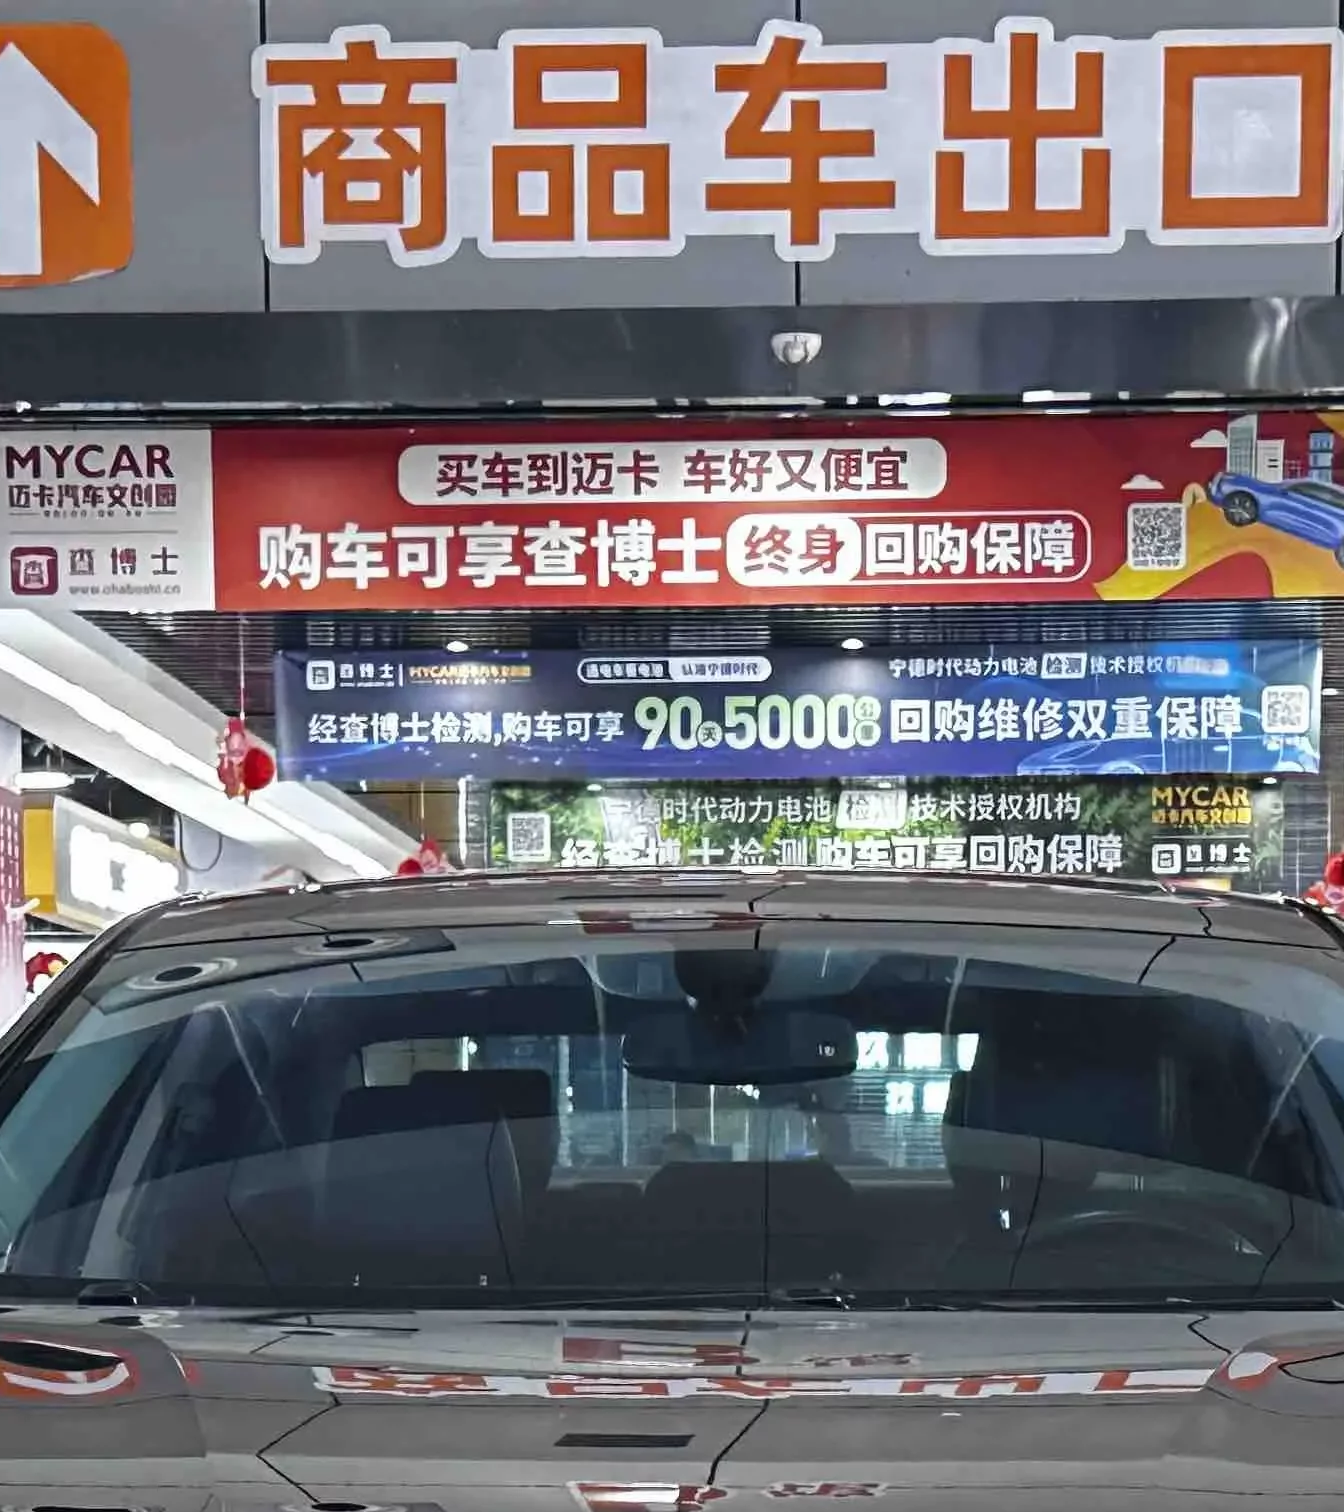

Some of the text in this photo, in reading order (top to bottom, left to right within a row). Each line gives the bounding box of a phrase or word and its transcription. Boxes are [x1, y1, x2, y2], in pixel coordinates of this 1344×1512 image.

[262, 32, 1334, 252] 商品车出口
[6, 444, 175, 478] MYCAR
[436, 447, 909, 497] 买车到迈卡 车好又便宜
[1151, 786, 1250, 807] MYCAR
